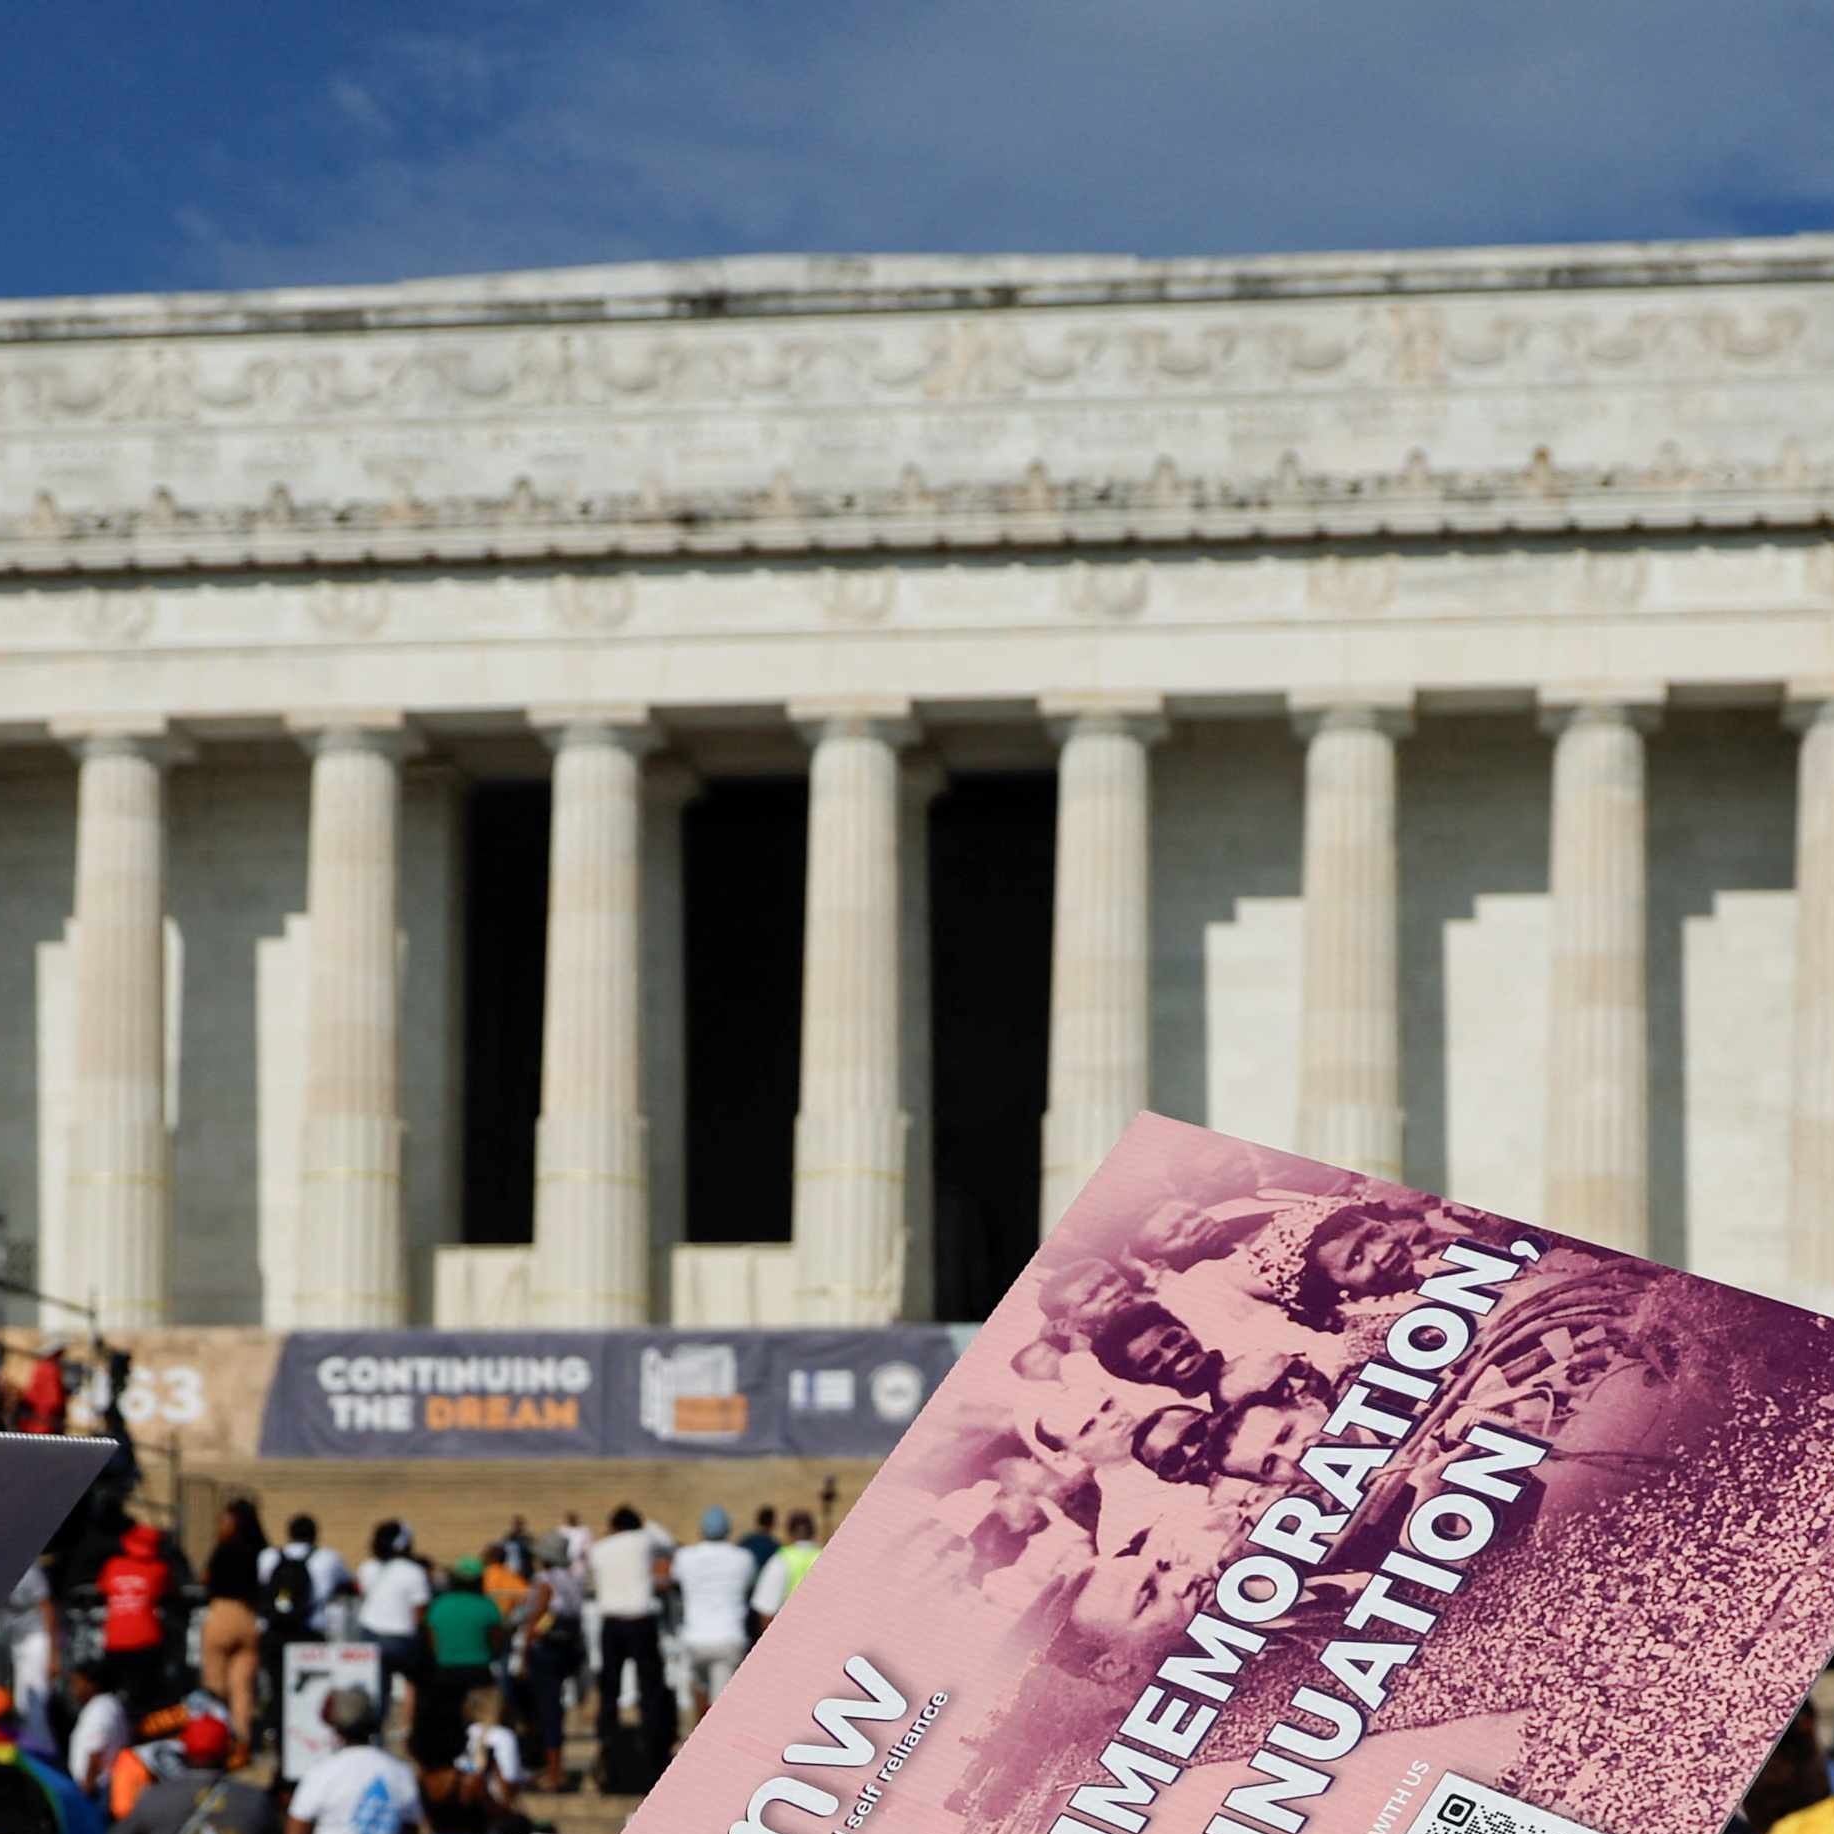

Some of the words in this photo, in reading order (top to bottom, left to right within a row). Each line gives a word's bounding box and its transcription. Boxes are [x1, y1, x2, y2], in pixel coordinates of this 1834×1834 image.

[317, 1355, 593, 1394] CONTINUING
[327, 1394, 415, 1432] THE
[425, 1395, 580, 1432] DREAM
[844, 1781, 884, 1831] self
[878, 1691, 949, 1782] reliance
[1406, 1759, 1431, 1790] US
